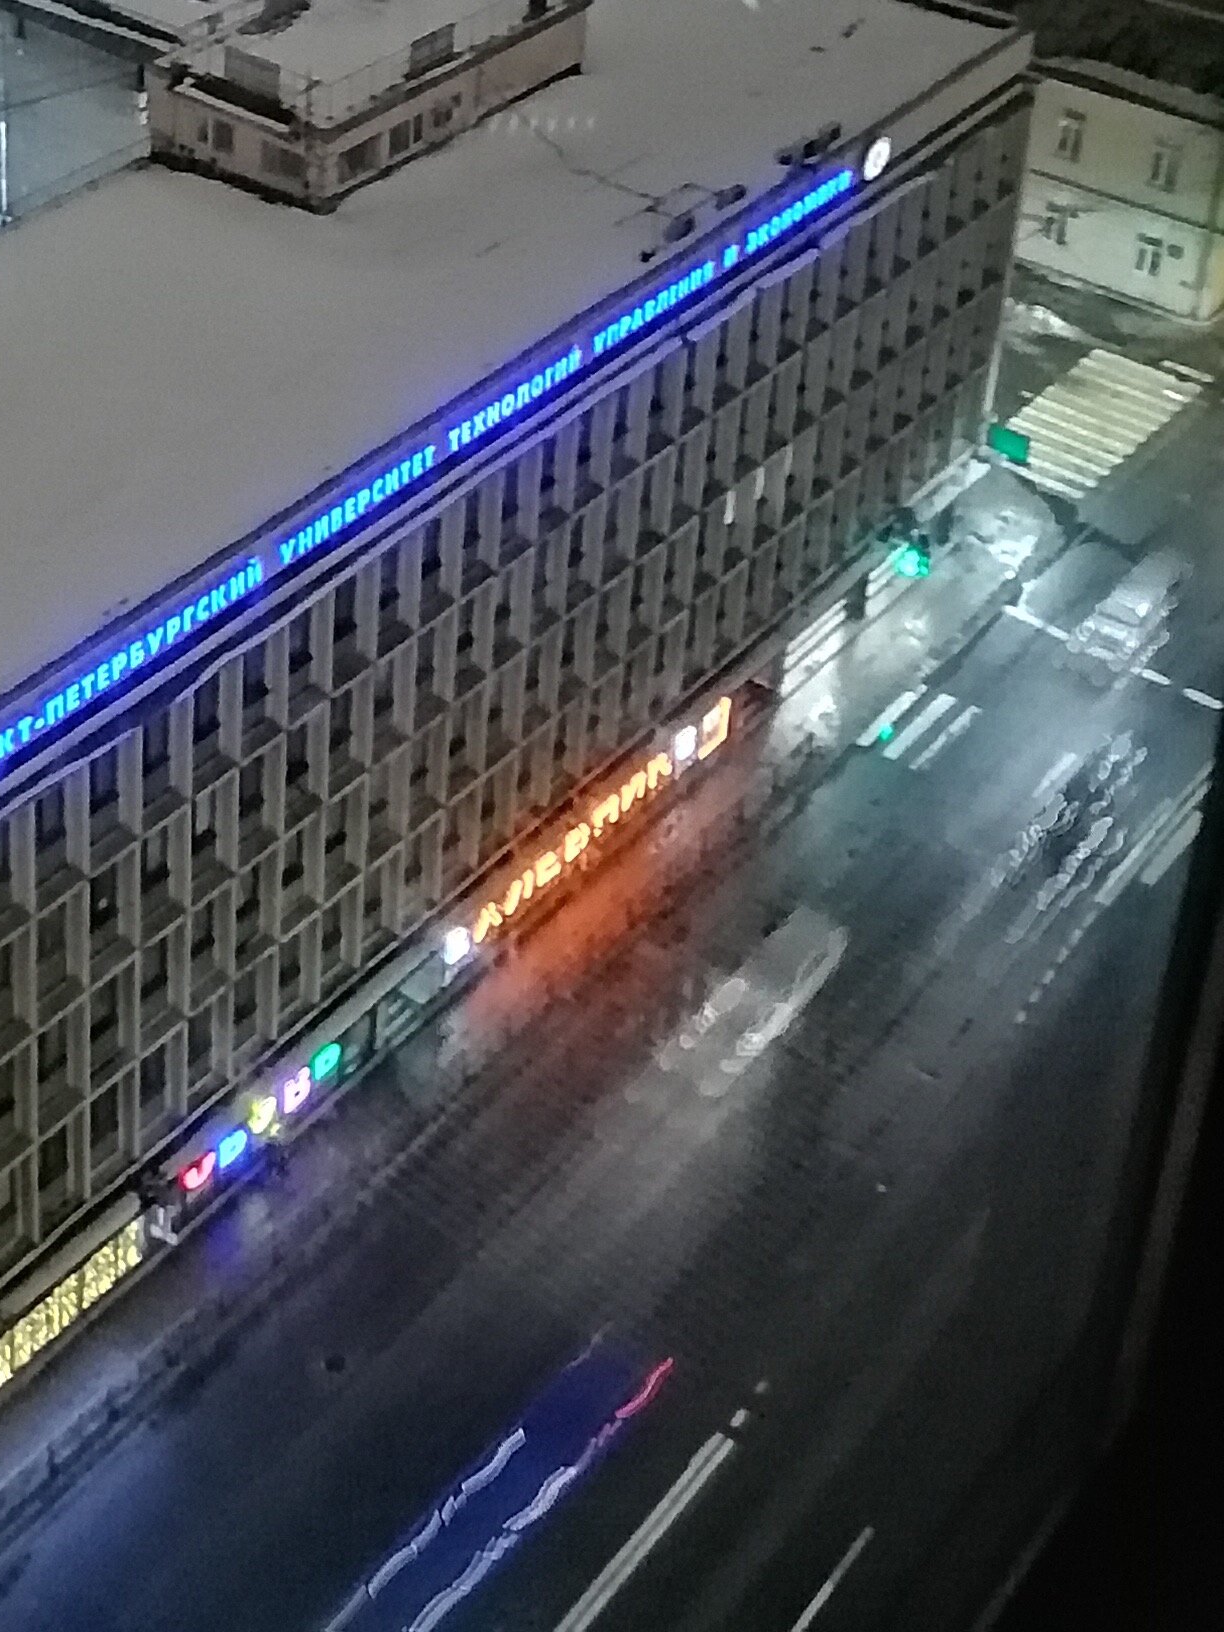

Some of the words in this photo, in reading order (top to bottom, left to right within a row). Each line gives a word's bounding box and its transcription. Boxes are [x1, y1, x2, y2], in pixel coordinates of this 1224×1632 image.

[278, 444, 437, 566] УНИВЕРСИТЕТ
[447, 343, 583, 453] ТЕХНОЛОГИЙ
[592, 260, 716, 355] УПРАВЛЕНИЯ
[722, 243, 740, 269] И
